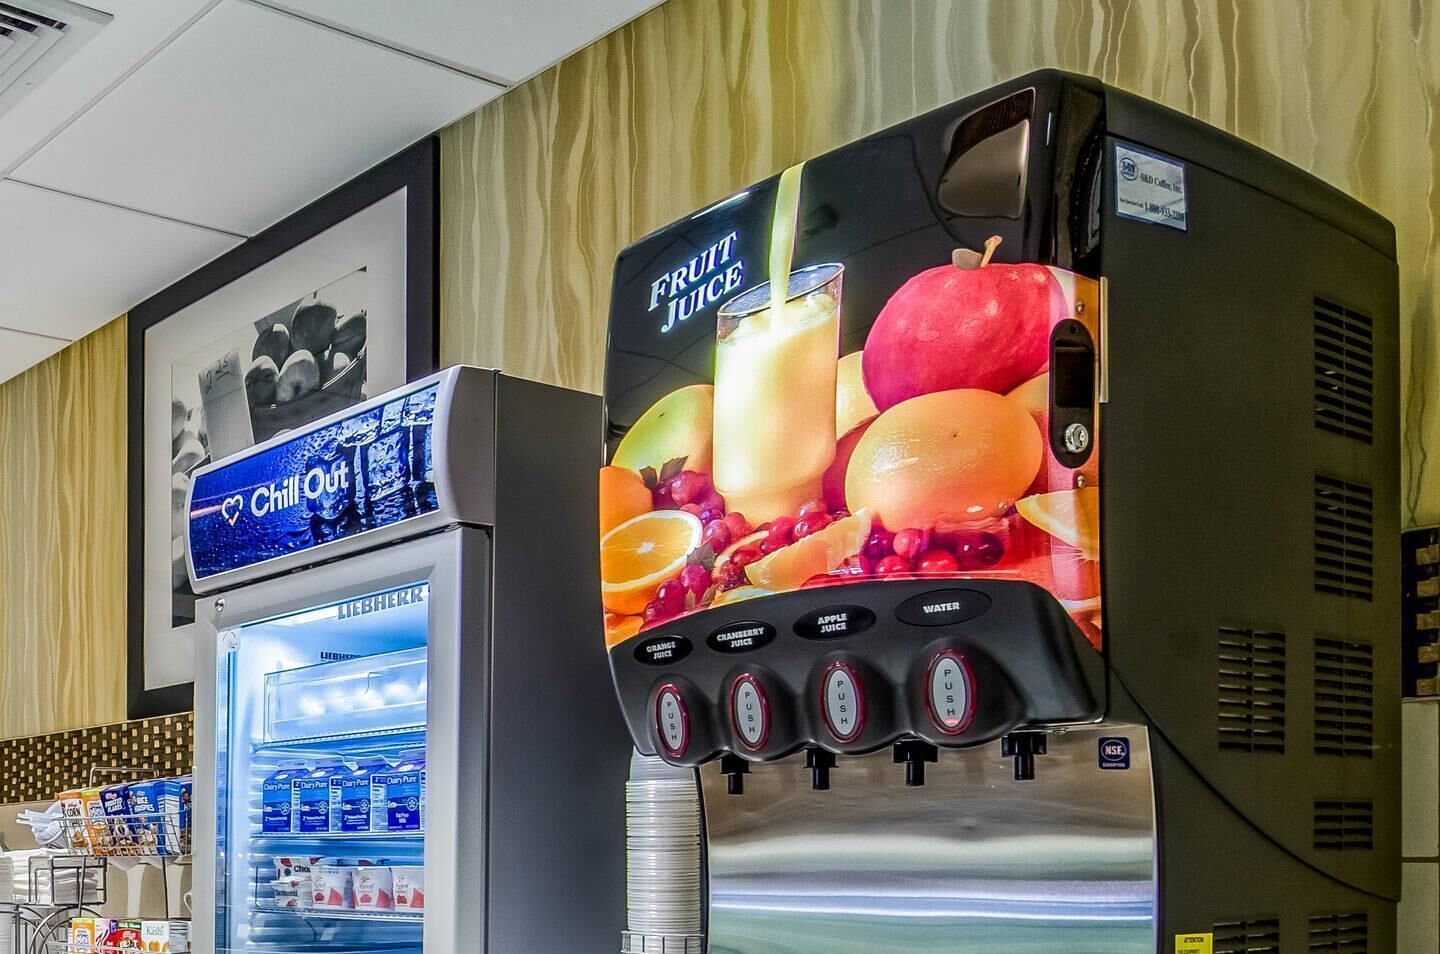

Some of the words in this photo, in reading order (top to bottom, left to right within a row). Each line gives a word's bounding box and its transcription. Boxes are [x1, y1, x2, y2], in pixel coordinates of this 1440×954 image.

[647, 231, 738, 312] FRUIT
[661, 260, 744, 334] JUICE
[250, 475, 300, 517] Chill
[303, 460, 349, 500] Out
[337, 586, 424, 620] LIEBHERR
[922, 602, 960, 614] WATER
[817, 613, 848, 625] APPLE
[716, 627, 764, 642] CRANBERRY
[820, 622, 847, 634] JUICE
[646, 641, 676, 653] ORANGE
[730, 639, 753, 648] JUICE
[320, 651, 361, 661] LIEBHE
[653, 650, 673, 660] JUICE
[943, 669, 956, 716] PUSH
[837, 680, 848, 725] PUSH
[744, 691, 756, 734] PUSH
[666, 701, 678, 741] PUSH
[66, 808, 81, 817] CORN
[146, 925, 164, 936] Kashi
